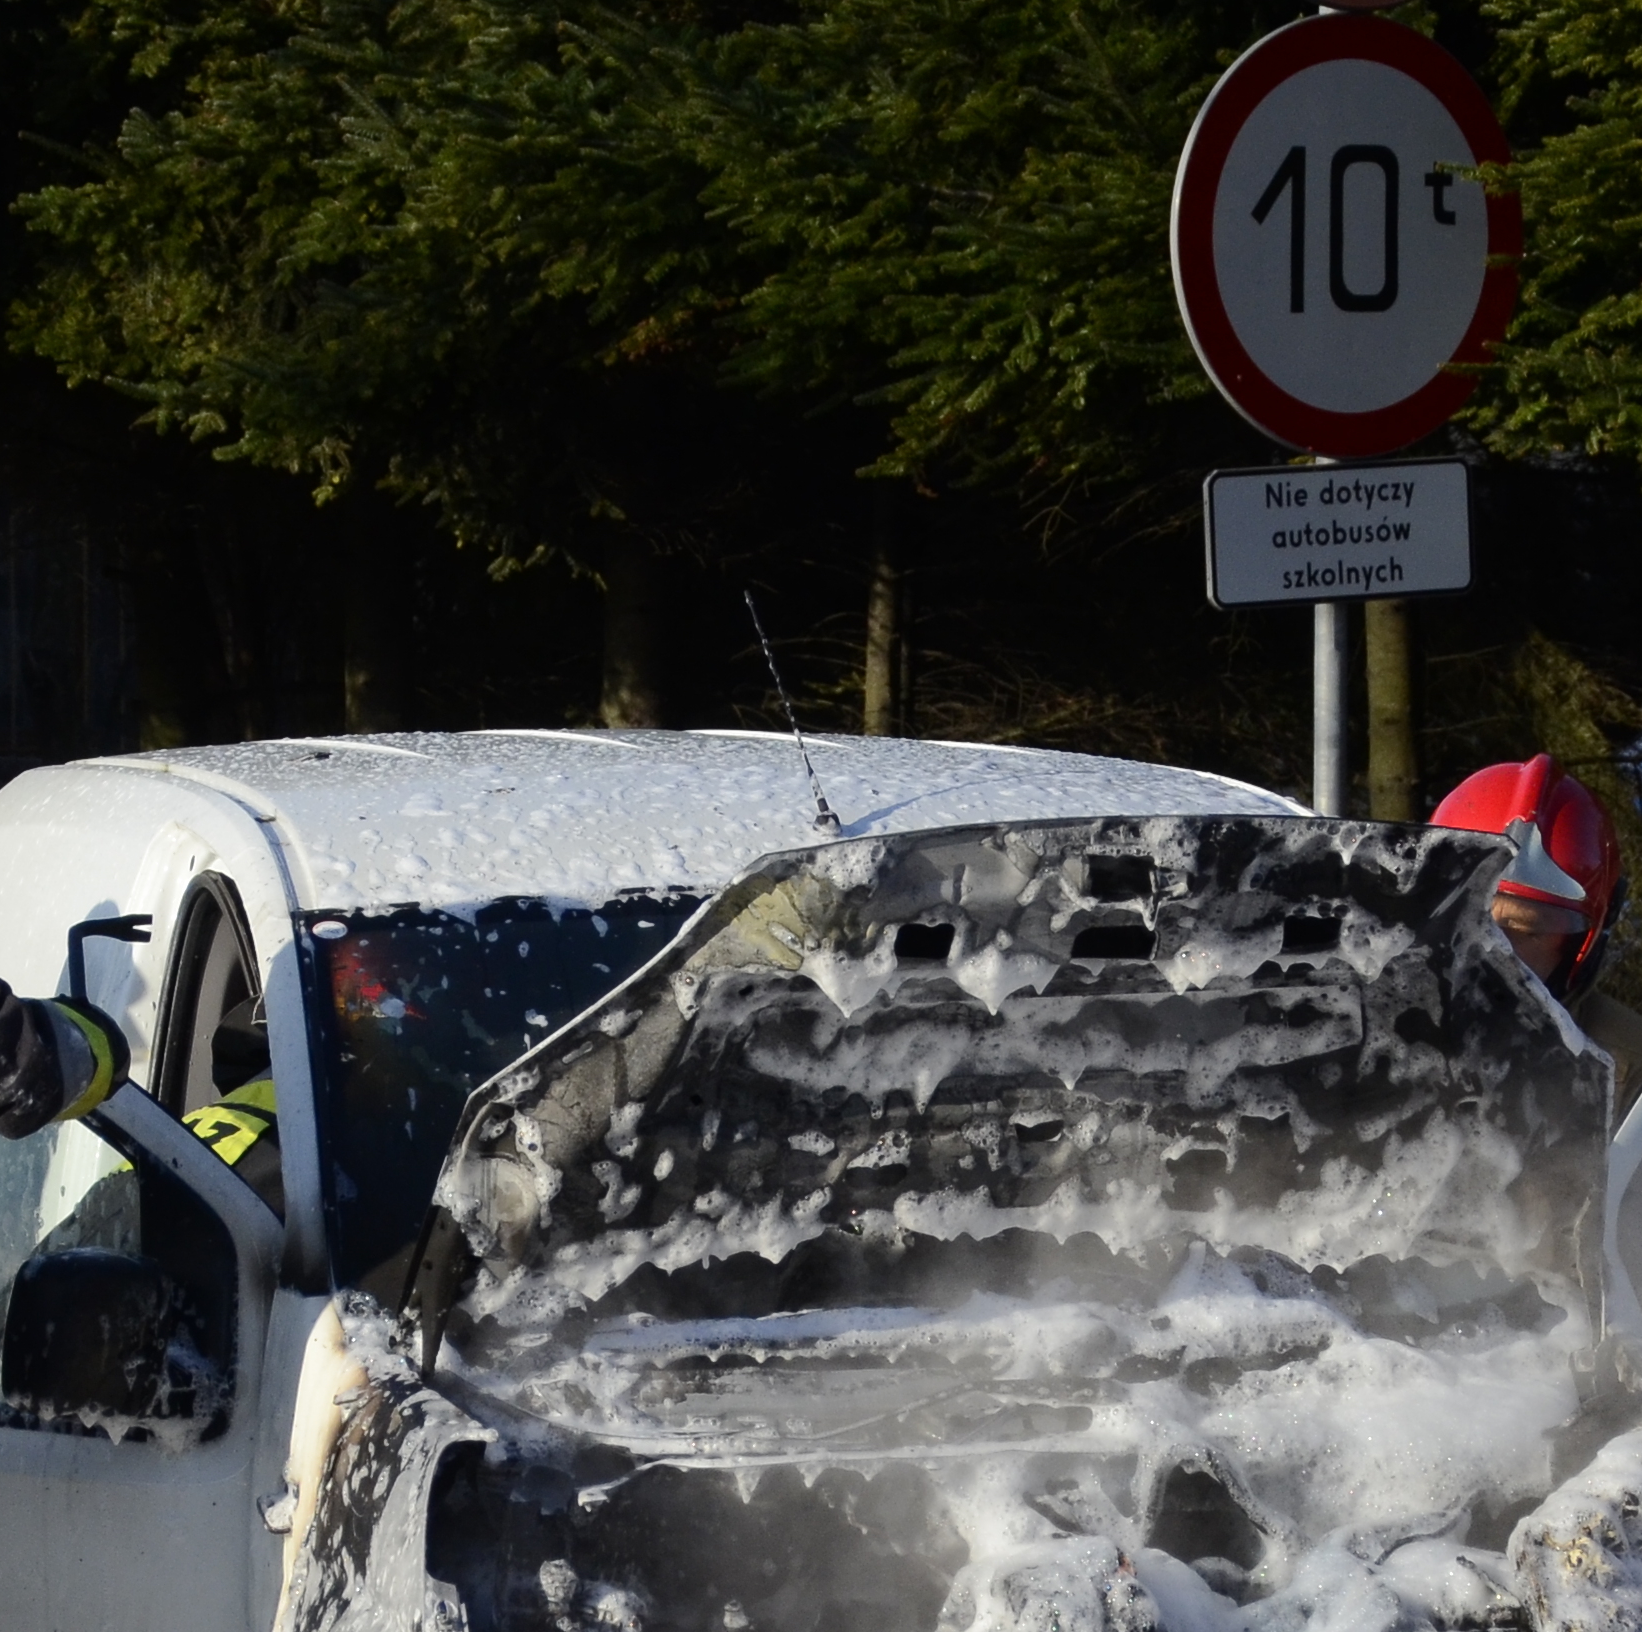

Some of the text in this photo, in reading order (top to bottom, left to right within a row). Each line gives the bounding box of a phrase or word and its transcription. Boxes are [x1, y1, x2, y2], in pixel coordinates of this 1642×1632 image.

[1265, 478, 1415, 511] Nie dotyczy
[1272, 516, 1411, 549] autobusów
[1283, 556, 1404, 592] szkolnych
